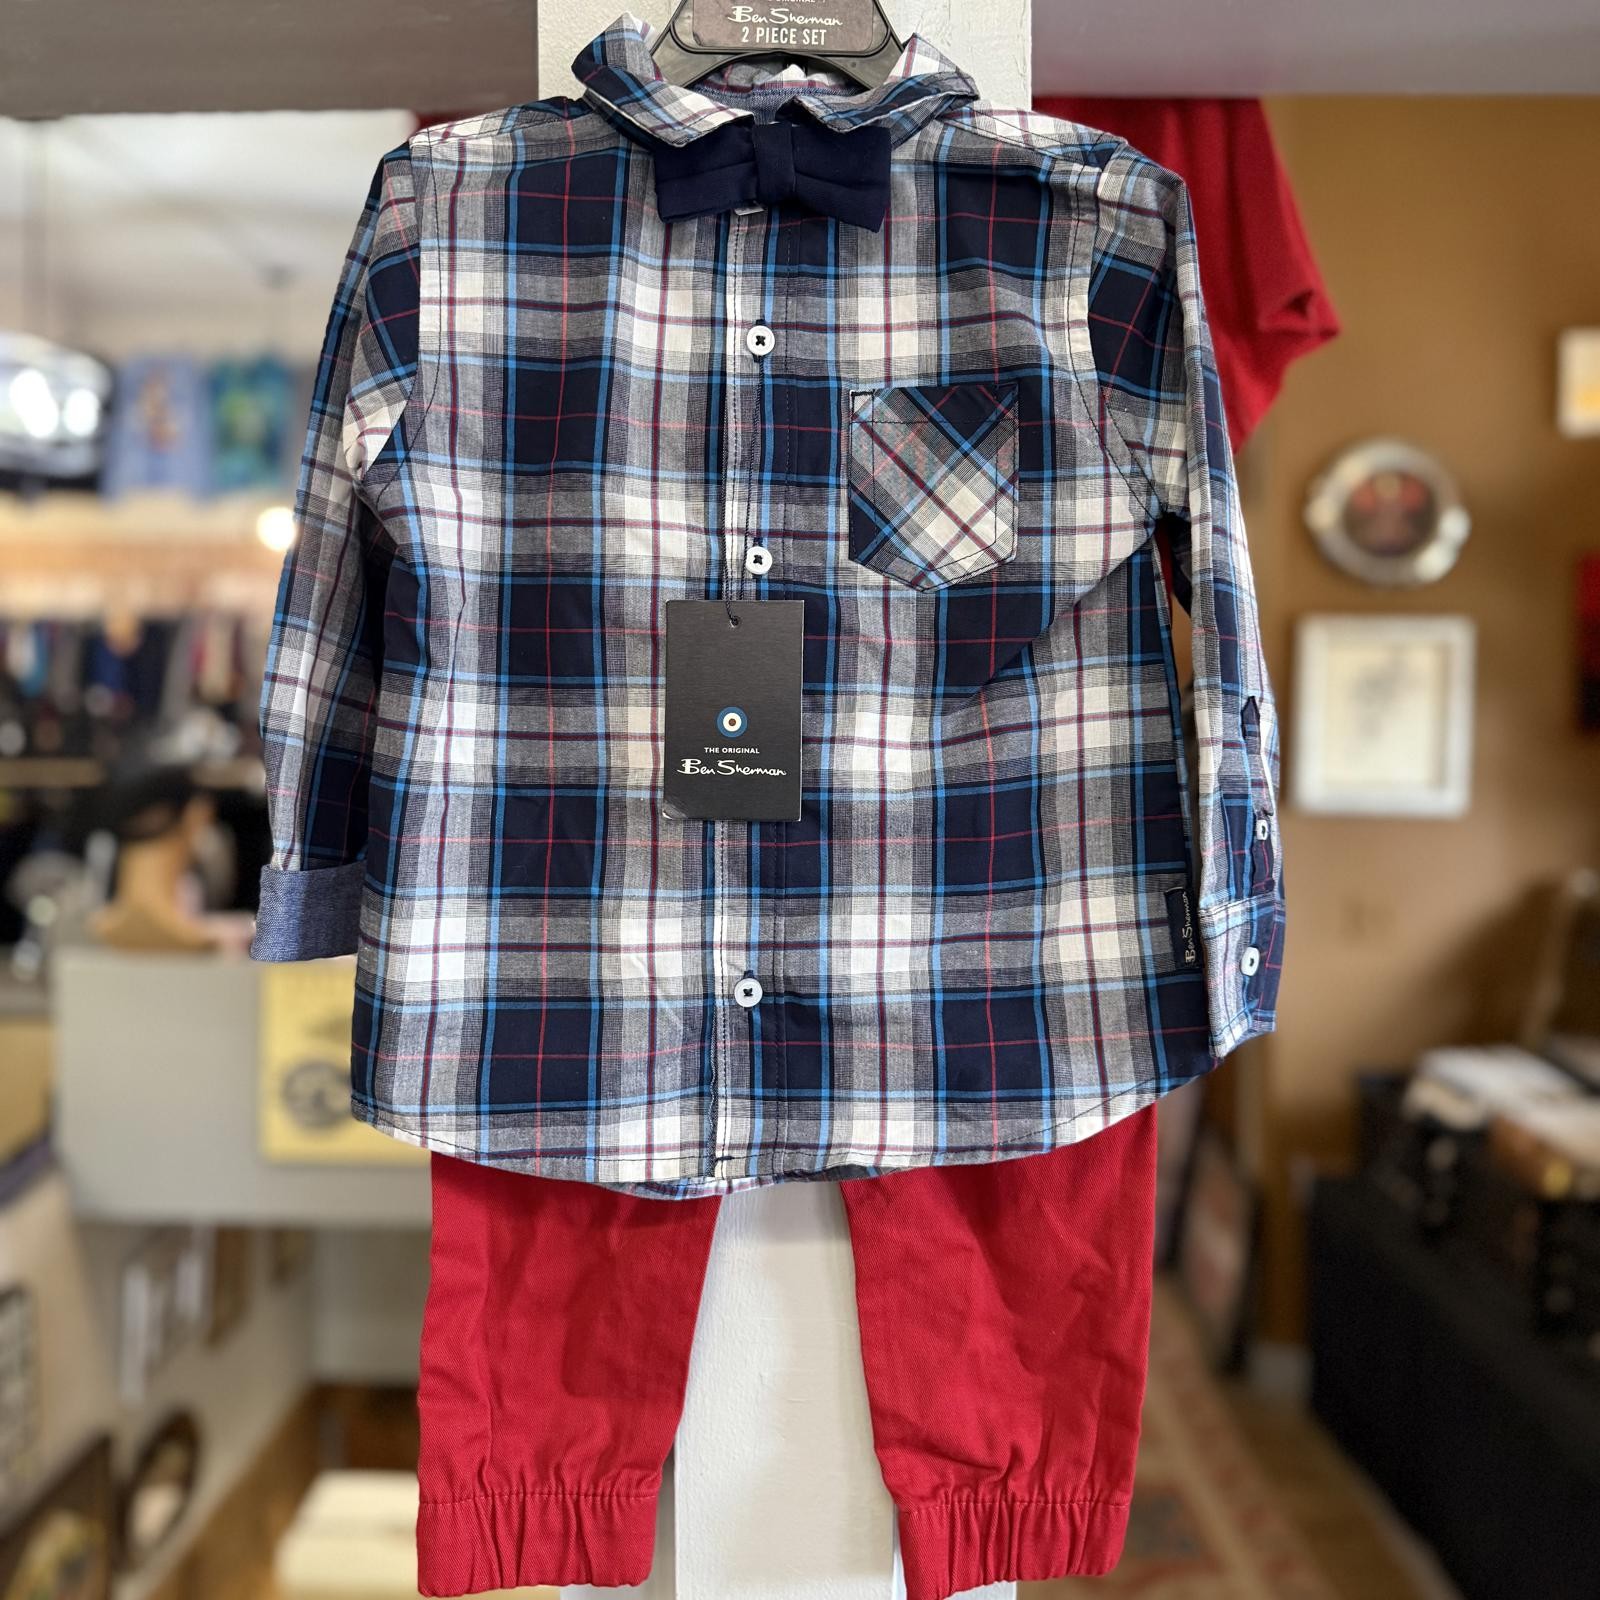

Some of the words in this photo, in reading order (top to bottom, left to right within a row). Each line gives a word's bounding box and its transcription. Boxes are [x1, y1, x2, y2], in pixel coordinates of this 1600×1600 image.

[727, 6, 768, 23] Ben
[769, 8, 843, 26] Sherman
[741, 27, 750, 43] 2
[755, 27, 797, 44] PIECE
[802, 29, 827, 46] SET
[676, 758, 716, 775] Ben
[716, 759, 787, 776] Sherman
[1184, 938, 1196, 963] Ben
